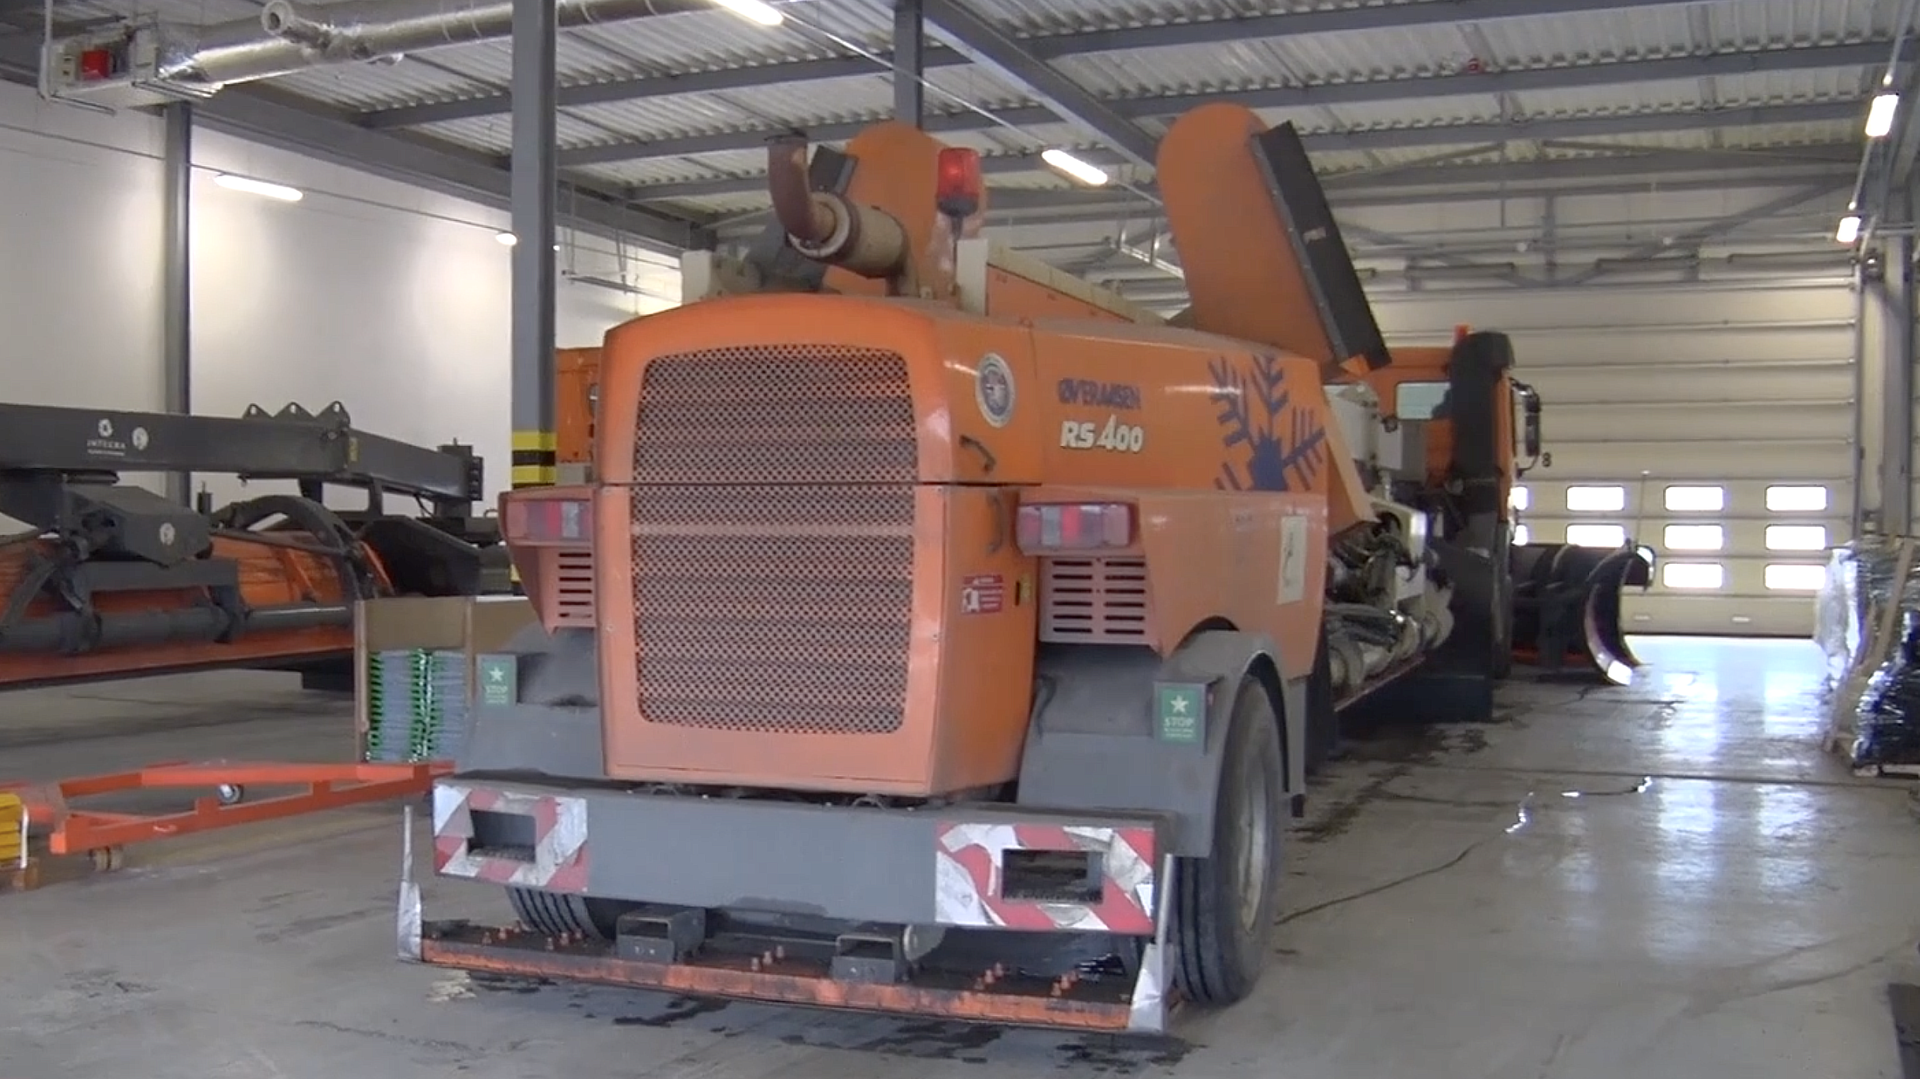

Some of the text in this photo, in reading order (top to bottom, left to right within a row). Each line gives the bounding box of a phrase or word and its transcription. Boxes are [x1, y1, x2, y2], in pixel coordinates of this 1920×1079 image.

[1060, 414, 1144, 452] RS 400
[1542, 452, 1551, 468] 8
[1163, 716, 1195, 728] STOP
